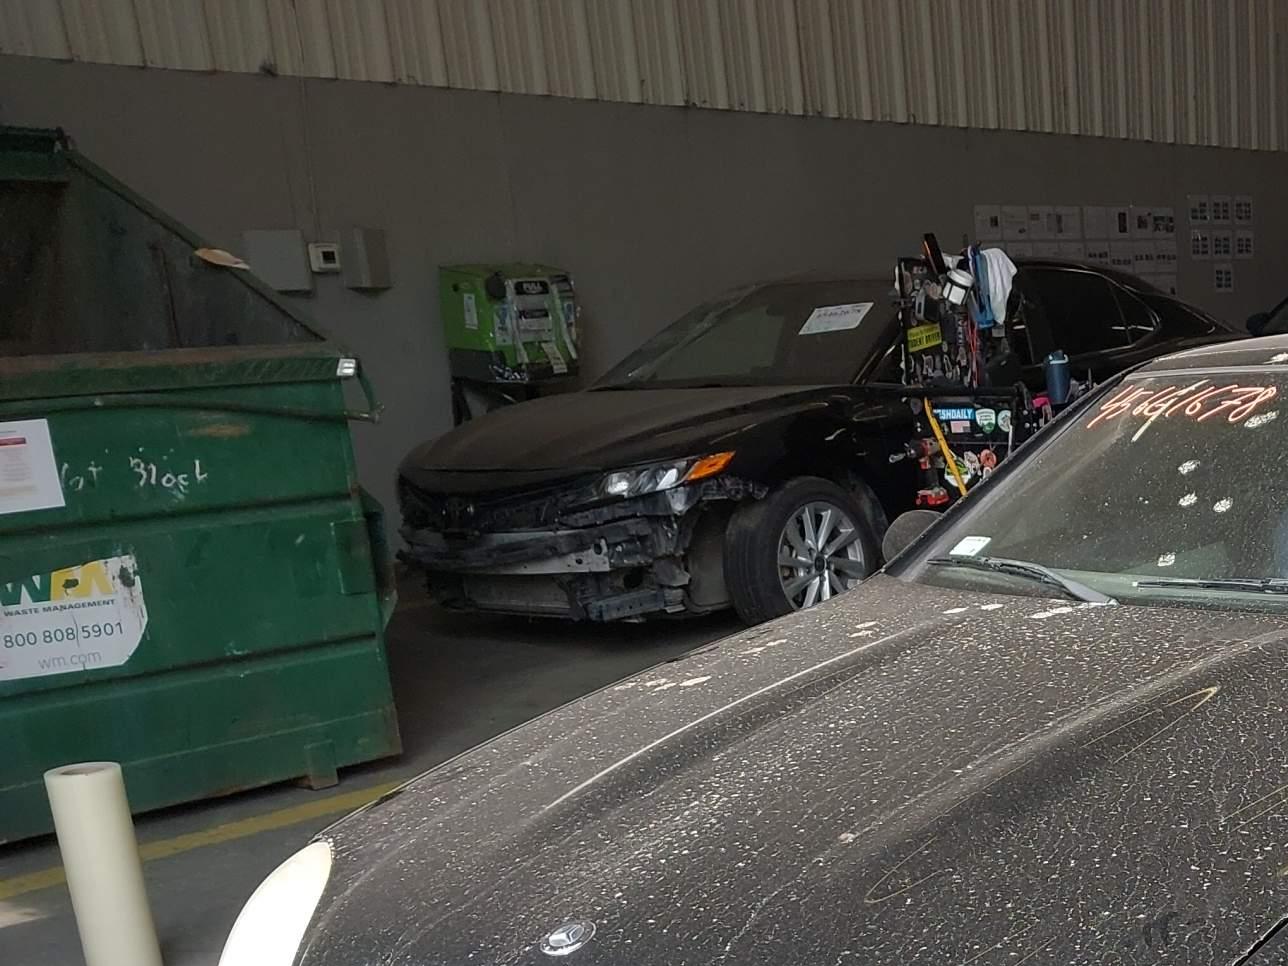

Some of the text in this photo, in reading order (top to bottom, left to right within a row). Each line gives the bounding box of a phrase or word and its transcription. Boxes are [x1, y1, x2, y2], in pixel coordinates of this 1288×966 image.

[3, 598, 116, 617] WASTE MANAGEMENT
[3, 621, 124, 649] 800 808 5901
[38, 650, 102, 670] wm.com
